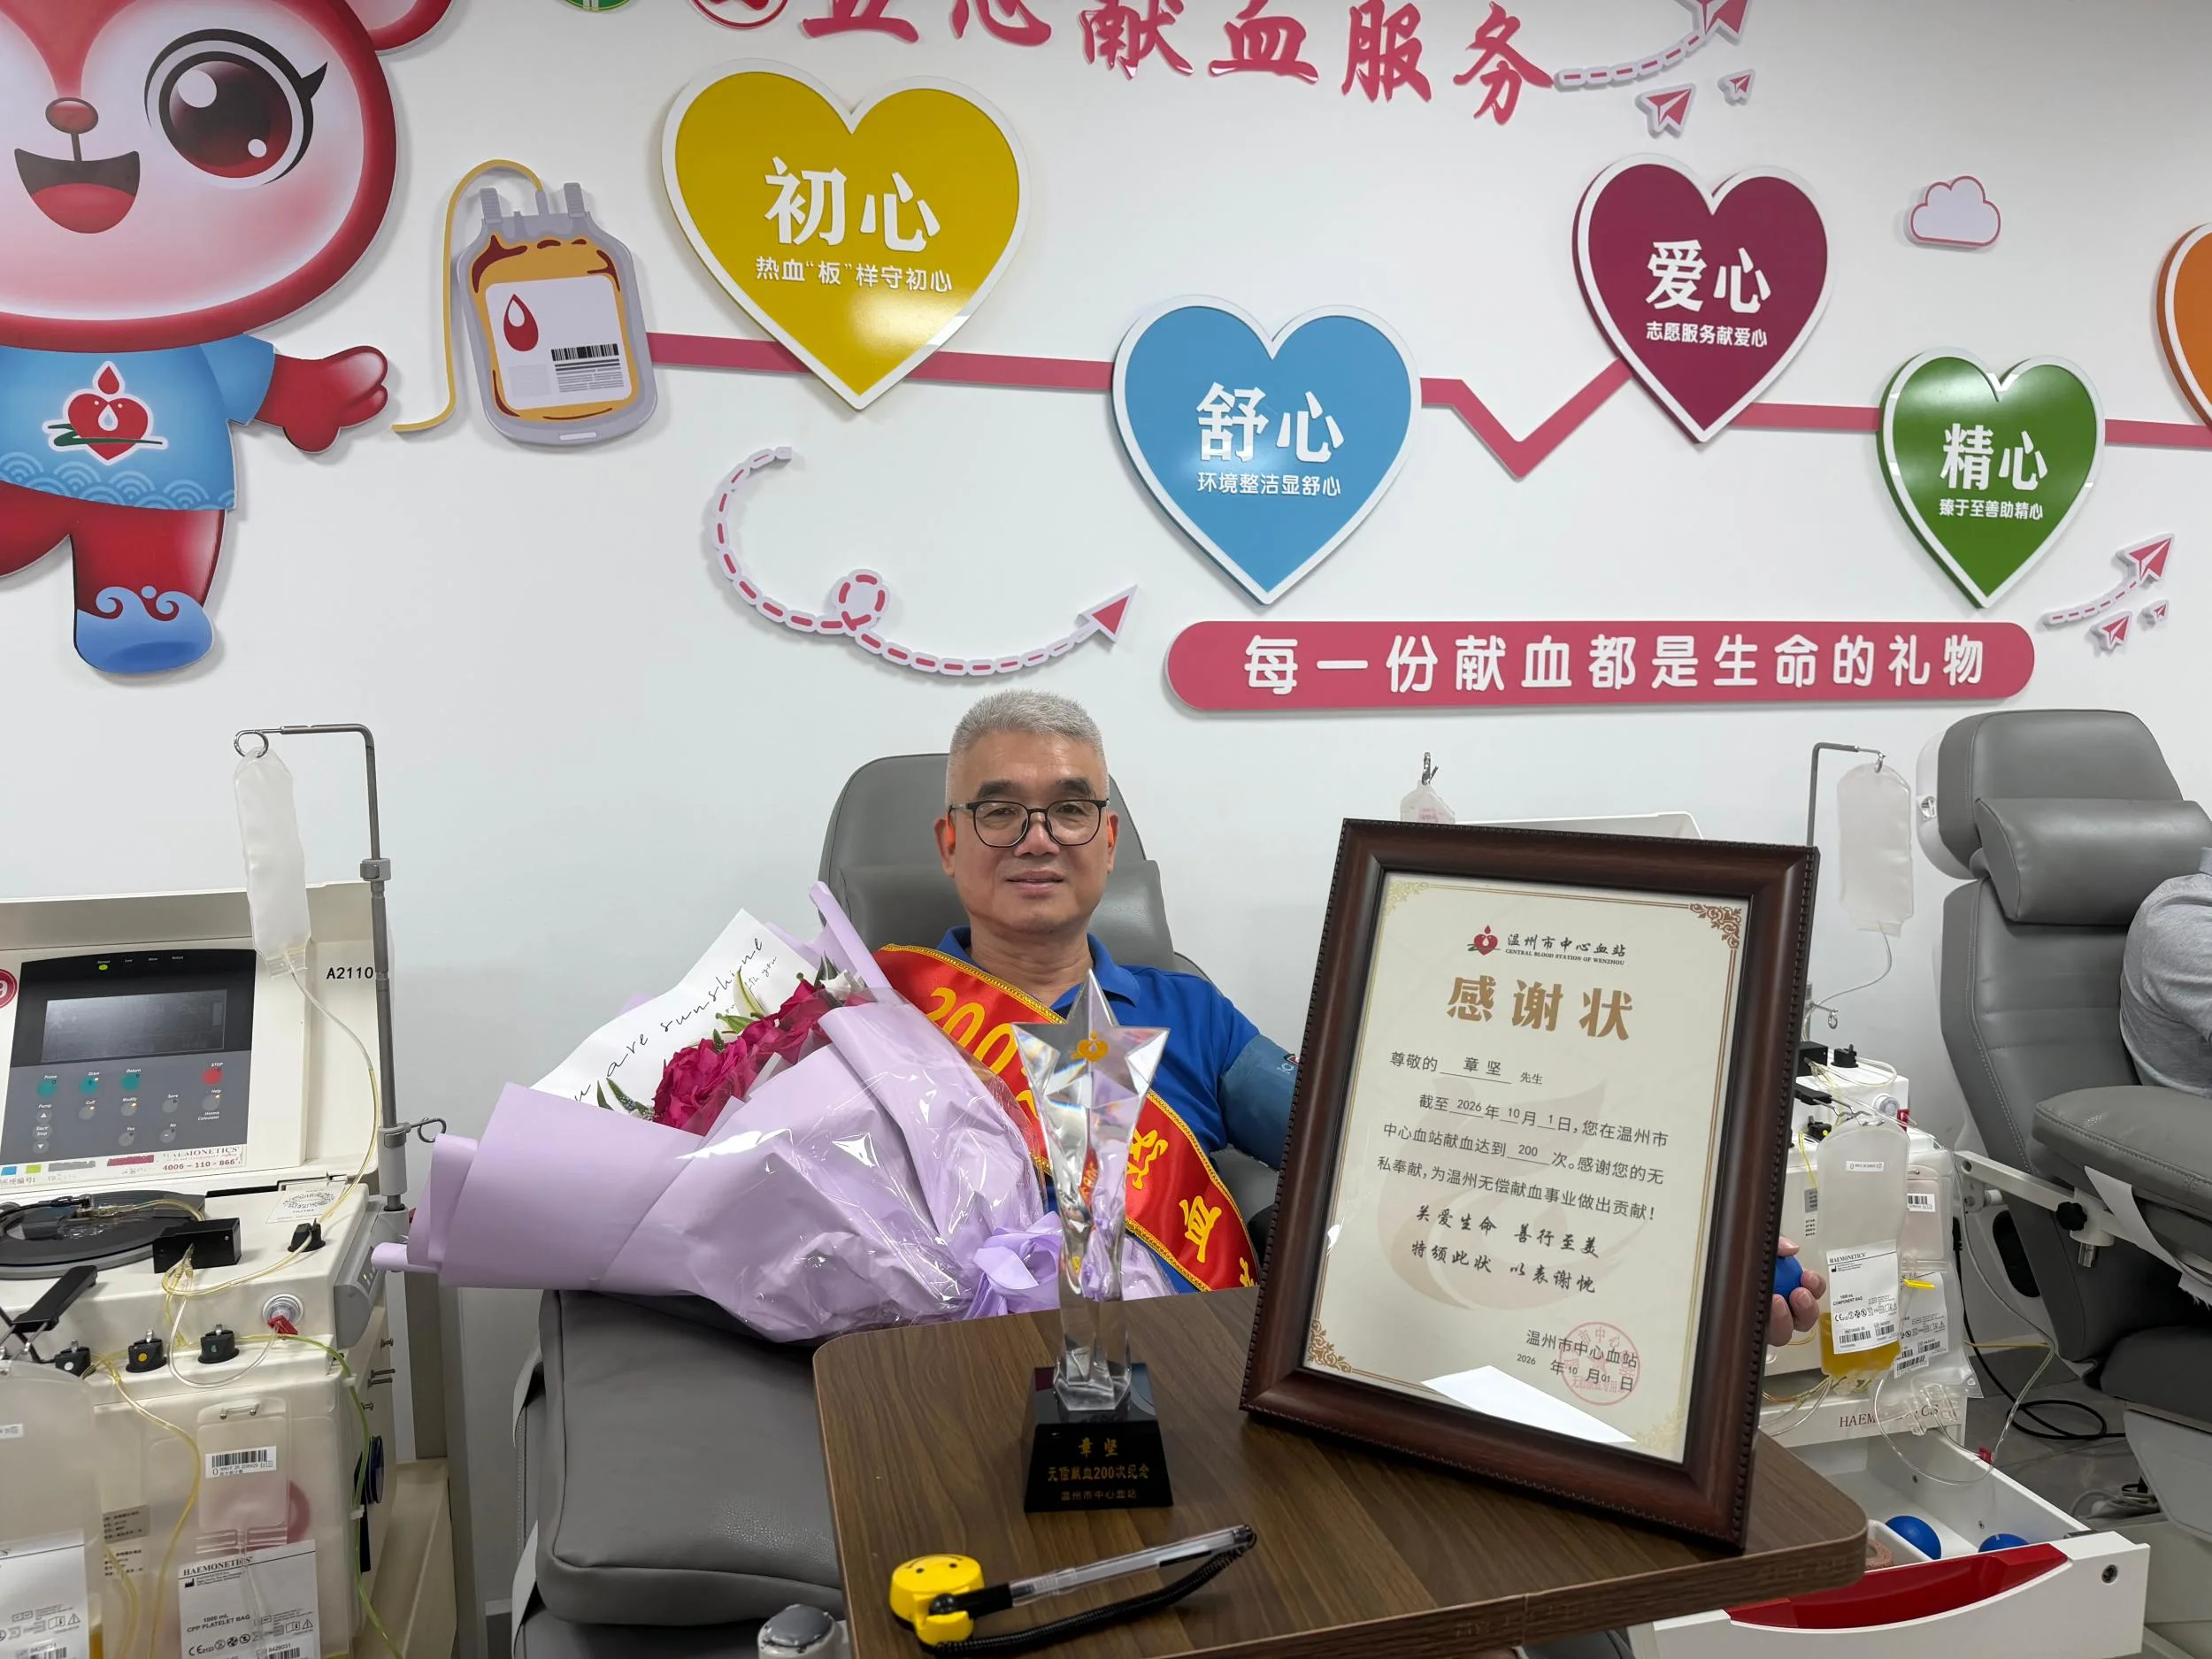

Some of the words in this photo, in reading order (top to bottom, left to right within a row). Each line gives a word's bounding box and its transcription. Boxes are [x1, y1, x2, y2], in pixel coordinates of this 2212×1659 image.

[764, 156, 940, 252] 初心
[756, 256, 952, 293] 热血“板”样守初心
[1647, 238, 1771, 314] 爱心
[1646, 320, 1768, 348] 志愿服务献爱心
[1196, 381, 1344, 464] 舒心
[1939, 422, 2047, 491] 精心
[1197, 471, 1340, 497] 环境整洁显舒心
[1939, 498, 2044, 520] 臻于至善助精心
[1244, 634, 1985, 696] 每一份献血都是生命的礼物
[1508, 933, 1626, 957] 温州市中心血站
[326, 966, 374, 980] A2110
[1447, 976, 1633, 1041] 感谢状
[607, 1033, 649, 1078] are
[1390, 1051, 1438, 1072] 尊敬的
[1520, 1071, 1543, 1085] 先生
[1416, 1204, 1498, 1237] 关爱生命
[1514, 1224, 1600, 1258] 善行至美
[1509, 1263, 1596, 1294] 以表谢忱
[1526, 1330, 1639, 1369] 温州市中心血站
[1839, 1404, 1939, 1427] HAEMCS
[1061, 1489, 1137, 1501] 温州市中心血站
[183, 1557, 251, 1576] HAEMONETICS
[201, 1618, 235, 1631] PLATELET
